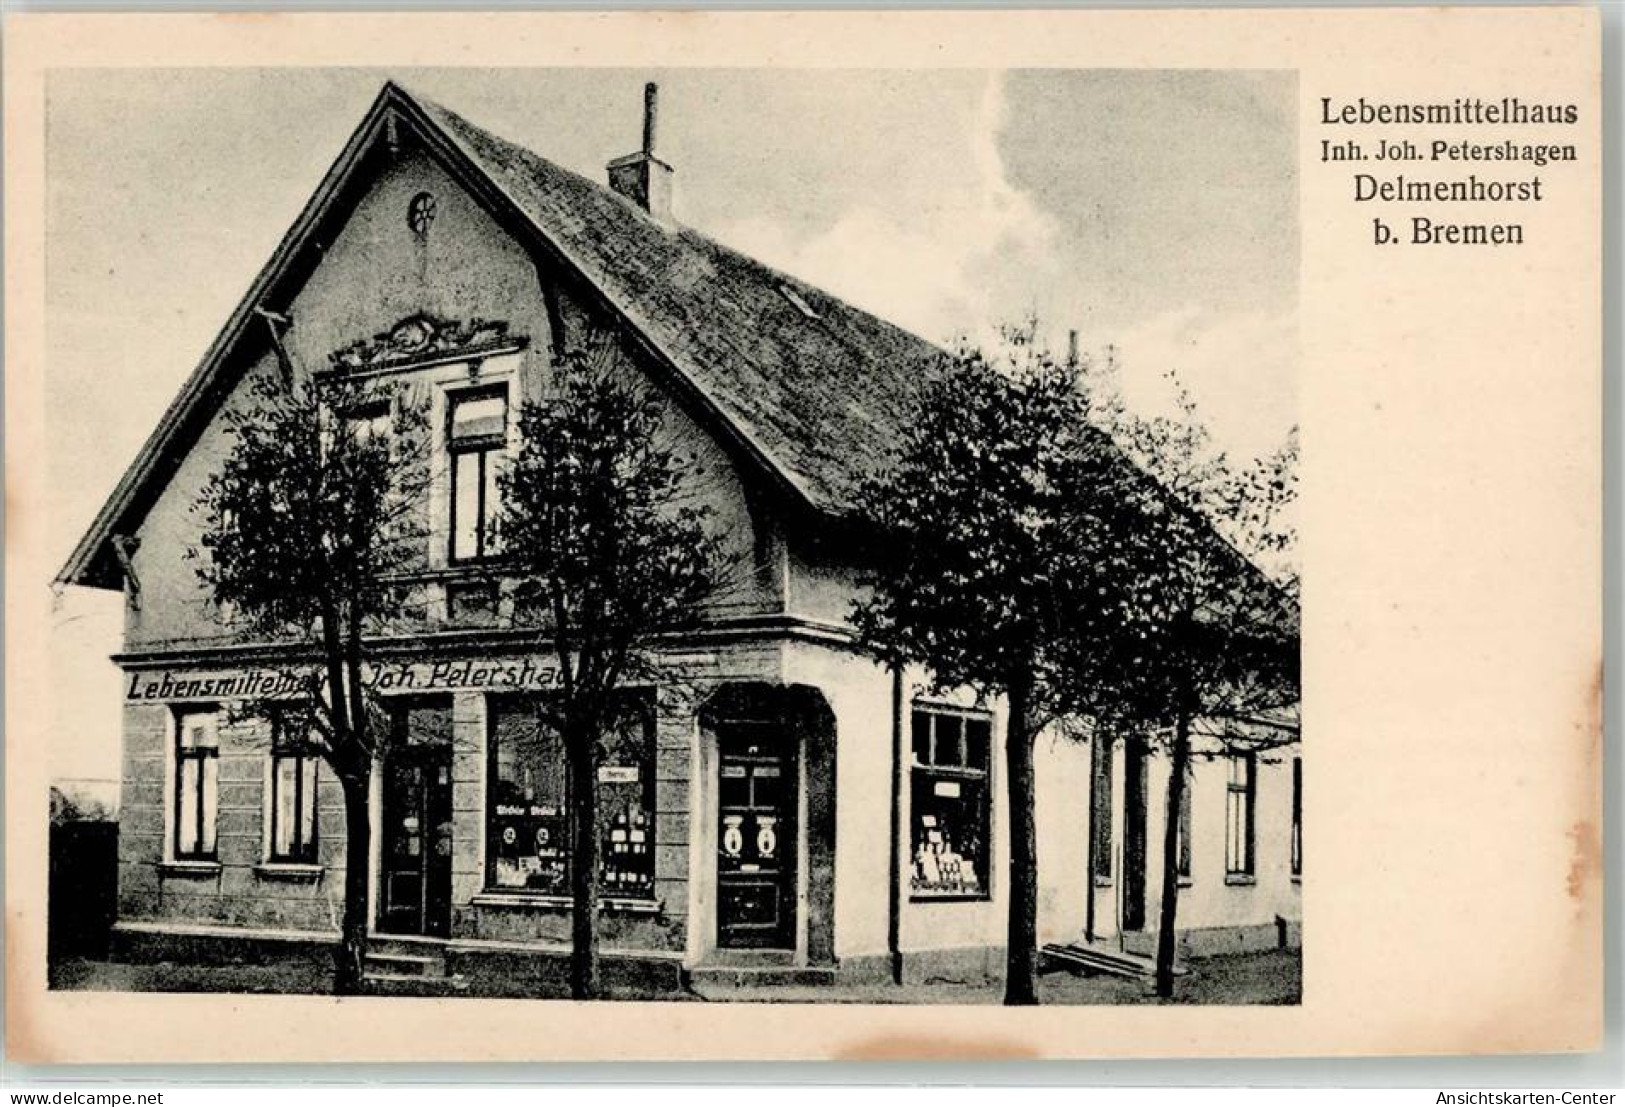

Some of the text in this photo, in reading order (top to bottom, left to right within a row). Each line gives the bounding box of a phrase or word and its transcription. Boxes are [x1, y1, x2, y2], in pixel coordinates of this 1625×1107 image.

[1321, 97, 1578, 125] Lebensmittelhaus
[1374, 139, 1424, 161] Joh.
[1430, 140, 1577, 166] Petershagen
[1354, 174, 1542, 202] Delmenhorst
[1373, 217, 1524, 246] b. Bremen
